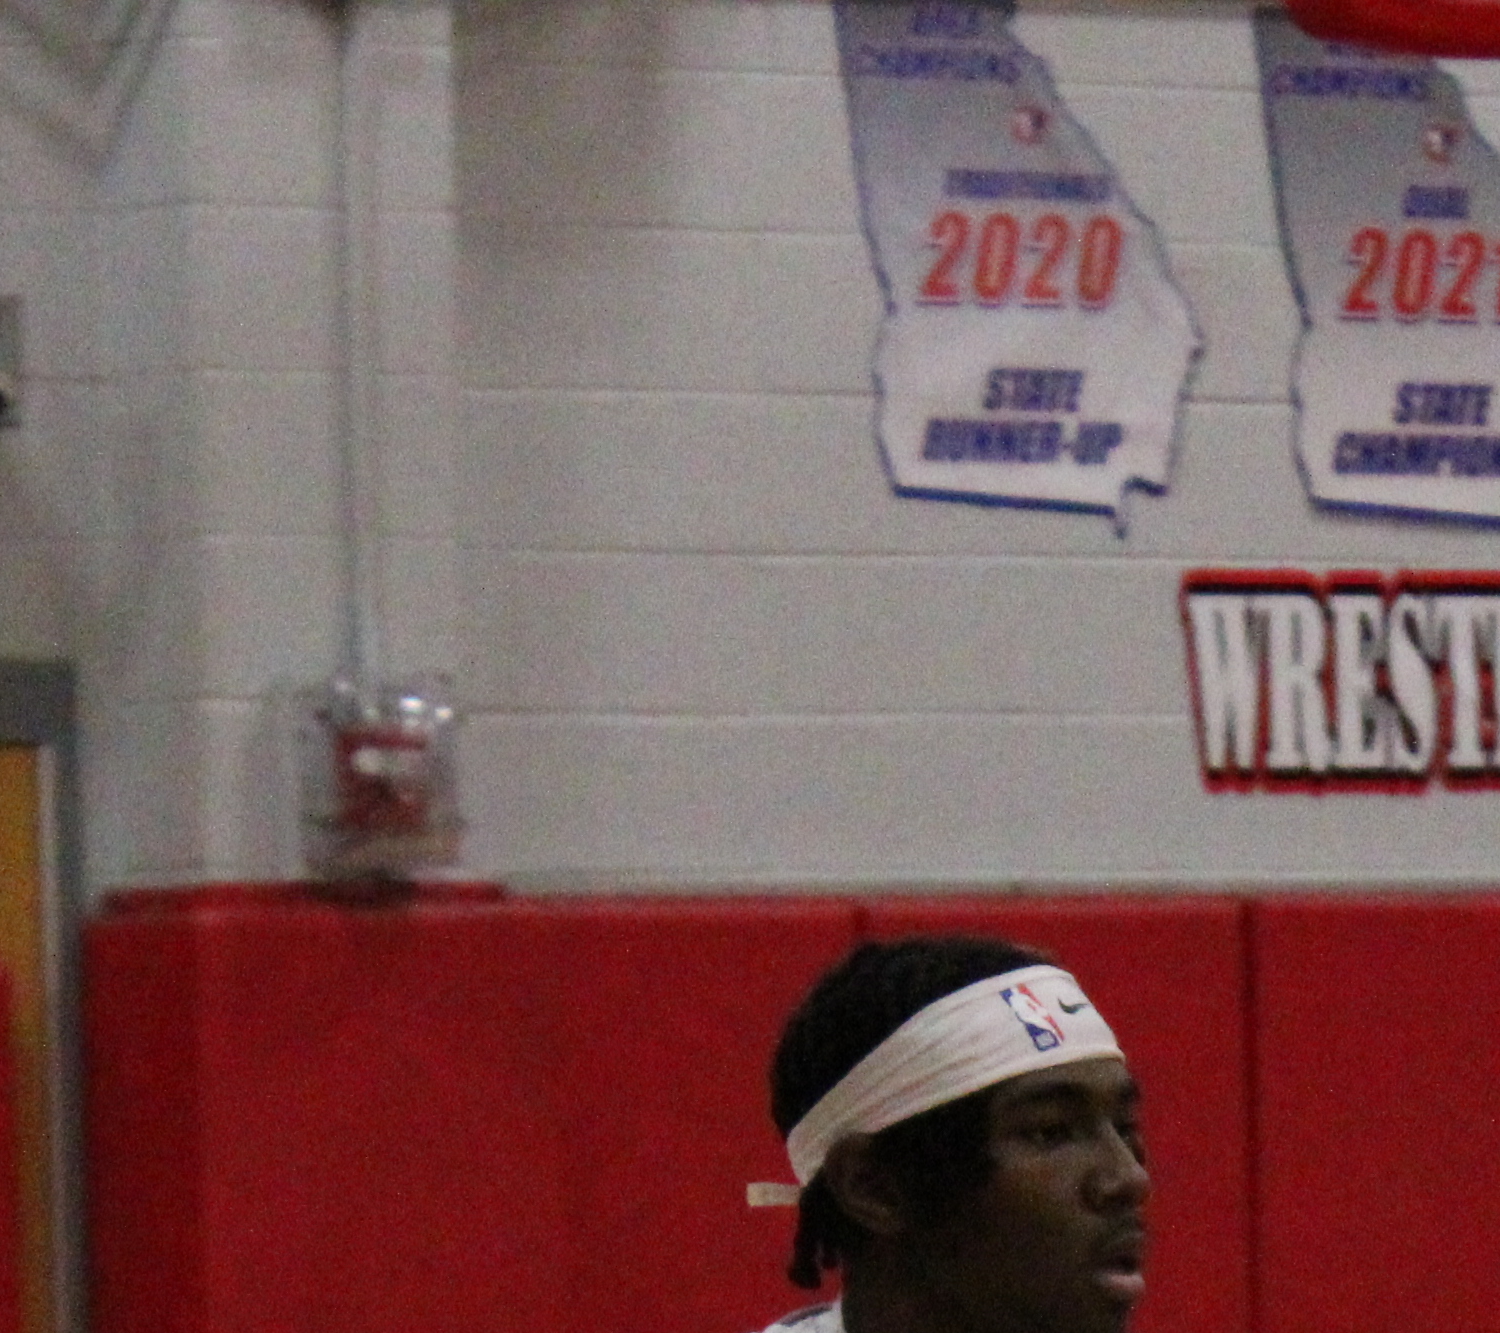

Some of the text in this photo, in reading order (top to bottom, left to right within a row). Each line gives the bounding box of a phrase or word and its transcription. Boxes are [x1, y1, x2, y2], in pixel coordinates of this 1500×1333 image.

[915, 211, 1122, 308] 2020
[981, 368, 1083, 412] STATE
[1394, 381, 1493, 426] STATE
[922, 418, 1124, 466] RUNNER-UP
